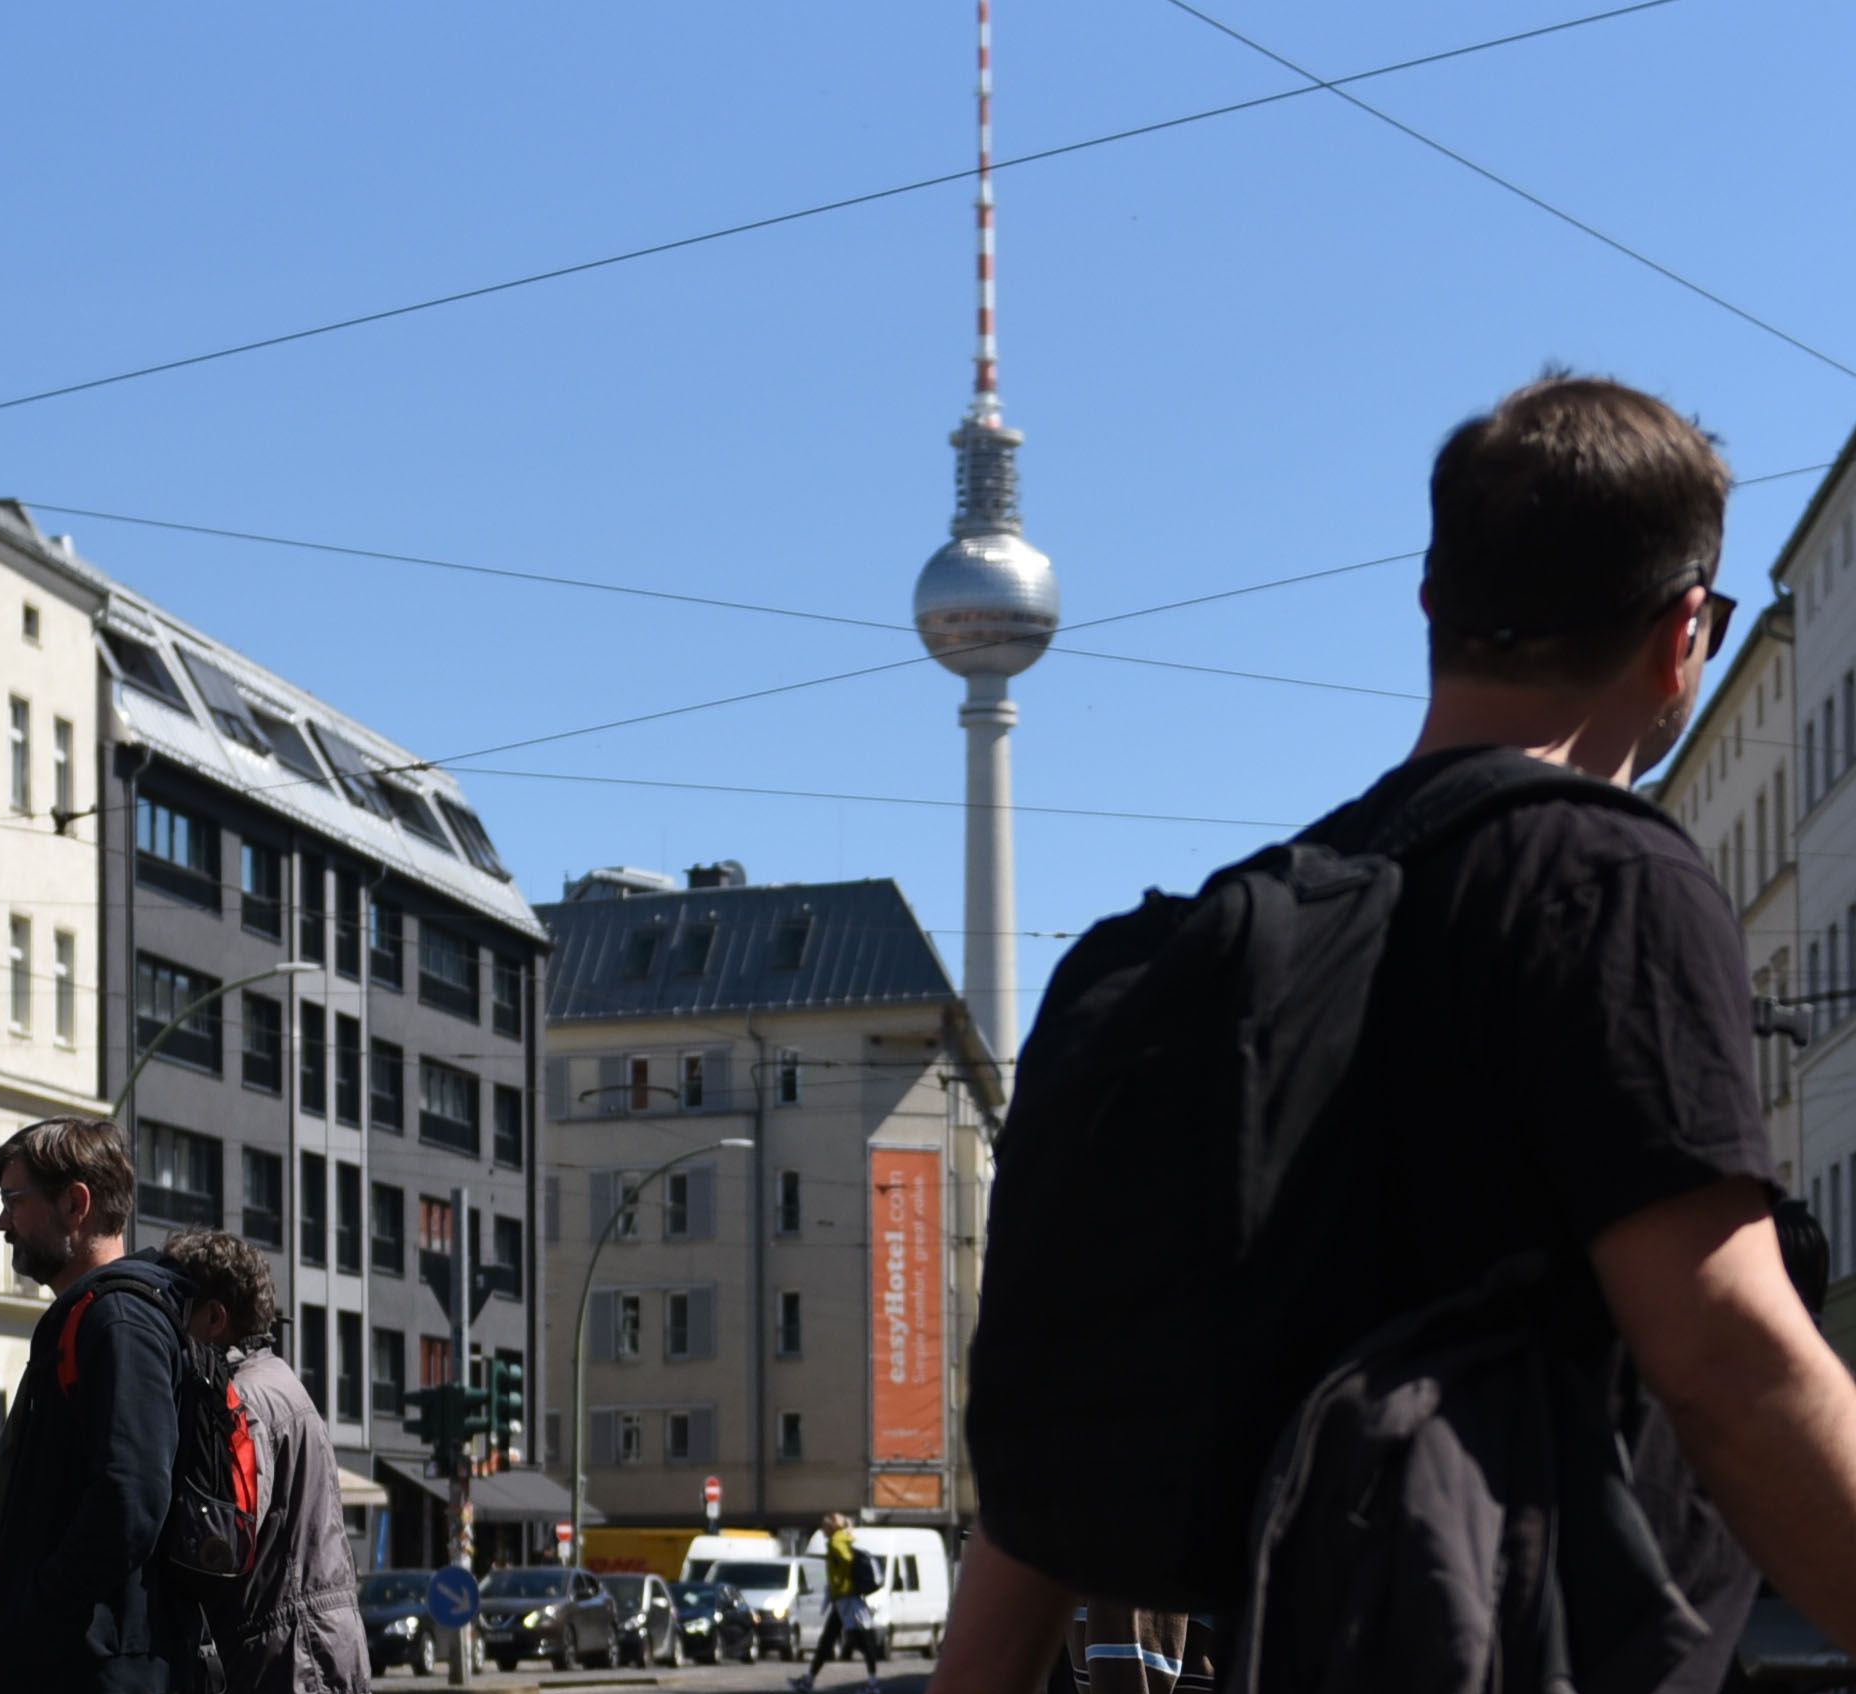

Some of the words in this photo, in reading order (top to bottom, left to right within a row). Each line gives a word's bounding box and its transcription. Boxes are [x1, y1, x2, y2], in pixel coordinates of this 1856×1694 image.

[912, 1220, 928, 1262] great
[884, 1169, 909, 1384] easyHotel.com
[912, 1332, 928, 1384] Simple
